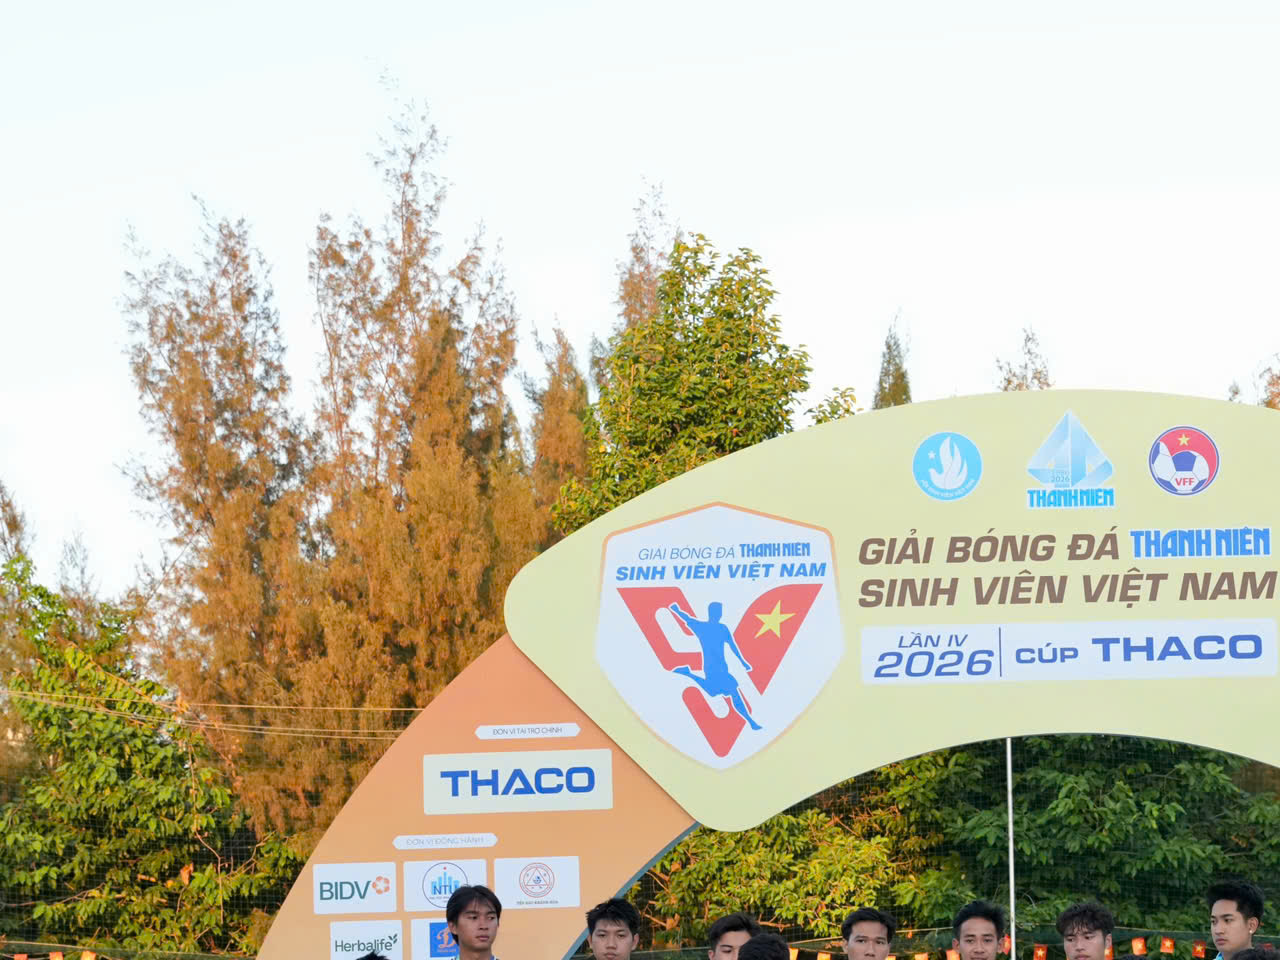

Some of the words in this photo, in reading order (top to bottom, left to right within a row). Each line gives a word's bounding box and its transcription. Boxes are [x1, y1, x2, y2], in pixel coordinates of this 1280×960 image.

[1175, 477, 1194, 487] VFF
[858, 528, 935, 565] GIẢI
[946, 528, 1057, 564] BÓNG
[1066, 525, 1121, 561] ĐÁ
[616, 566, 666, 581] SINH
[673, 561, 721, 580] VIÊN
[727, 561, 774, 581] VIỆT
[779, 562, 827, 578] NAM
[858, 577, 959, 608] SINH
[973, 569, 1068, 605] VIÊN
[1081, 567, 1168, 608] VIỆT
[1178, 570, 1278, 601] NAM
[898, 631, 940, 649] LẦN
[947, 633, 969, 647] IV
[1015, 641, 1079, 664] CÚP
[1091, 634, 1263, 663] THACO
[873, 649, 995, 678] 2026
[440, 766, 595, 797] THACO
[319, 880, 371, 901] BIDV
[335, 938, 393, 952] Herbalife
